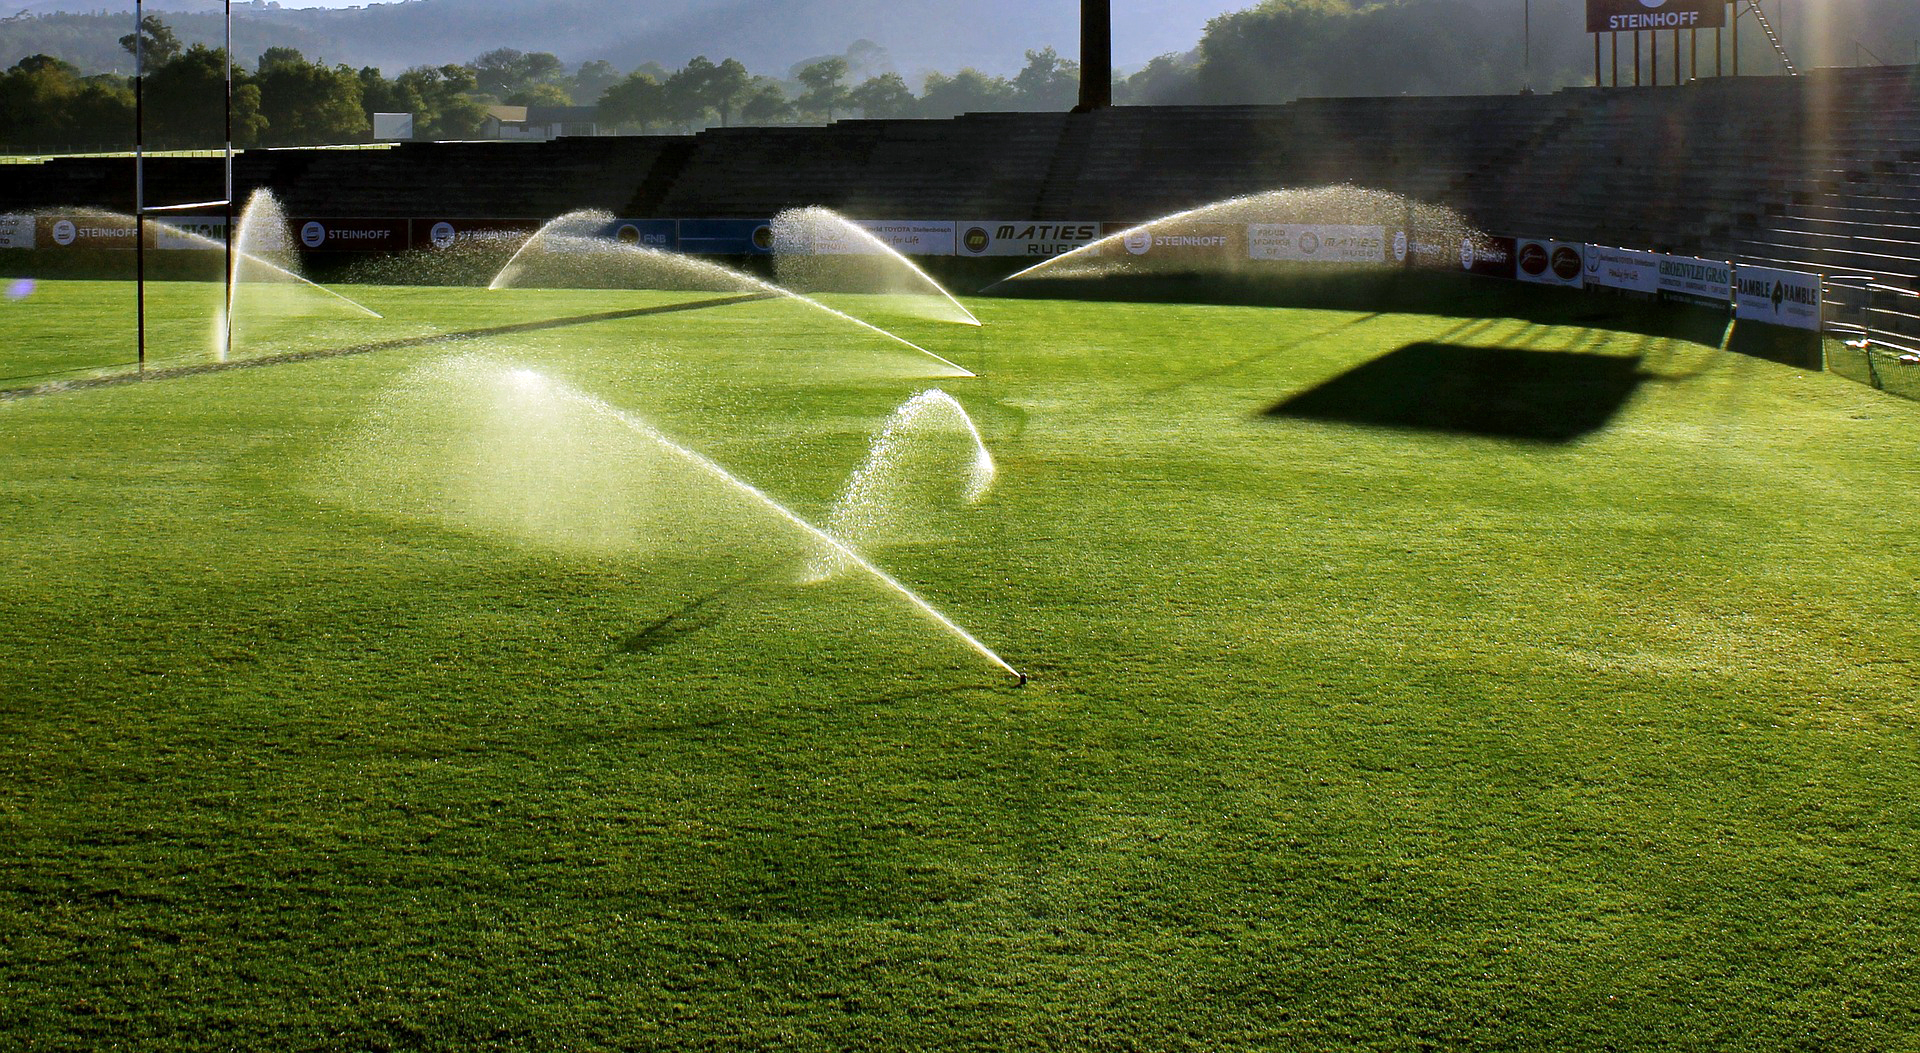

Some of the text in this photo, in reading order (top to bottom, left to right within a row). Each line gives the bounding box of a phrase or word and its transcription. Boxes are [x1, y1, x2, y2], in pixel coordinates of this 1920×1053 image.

[1610, 11, 1699, 29] STEINHOFF
[79, 228, 138, 238] STEINHOFF
[328, 229, 391, 239] STEINHOFF
[995, 225, 1096, 240] MATIES
[1155, 236, 1227, 247] STEINHOFF
[1659, 260, 1704, 280] GROENVLEI
[1706, 266, 1728, 284] GRAS
[1738, 278, 1770, 298] RAMBLE
[1784, 284, 1817, 306] RAMBLE
